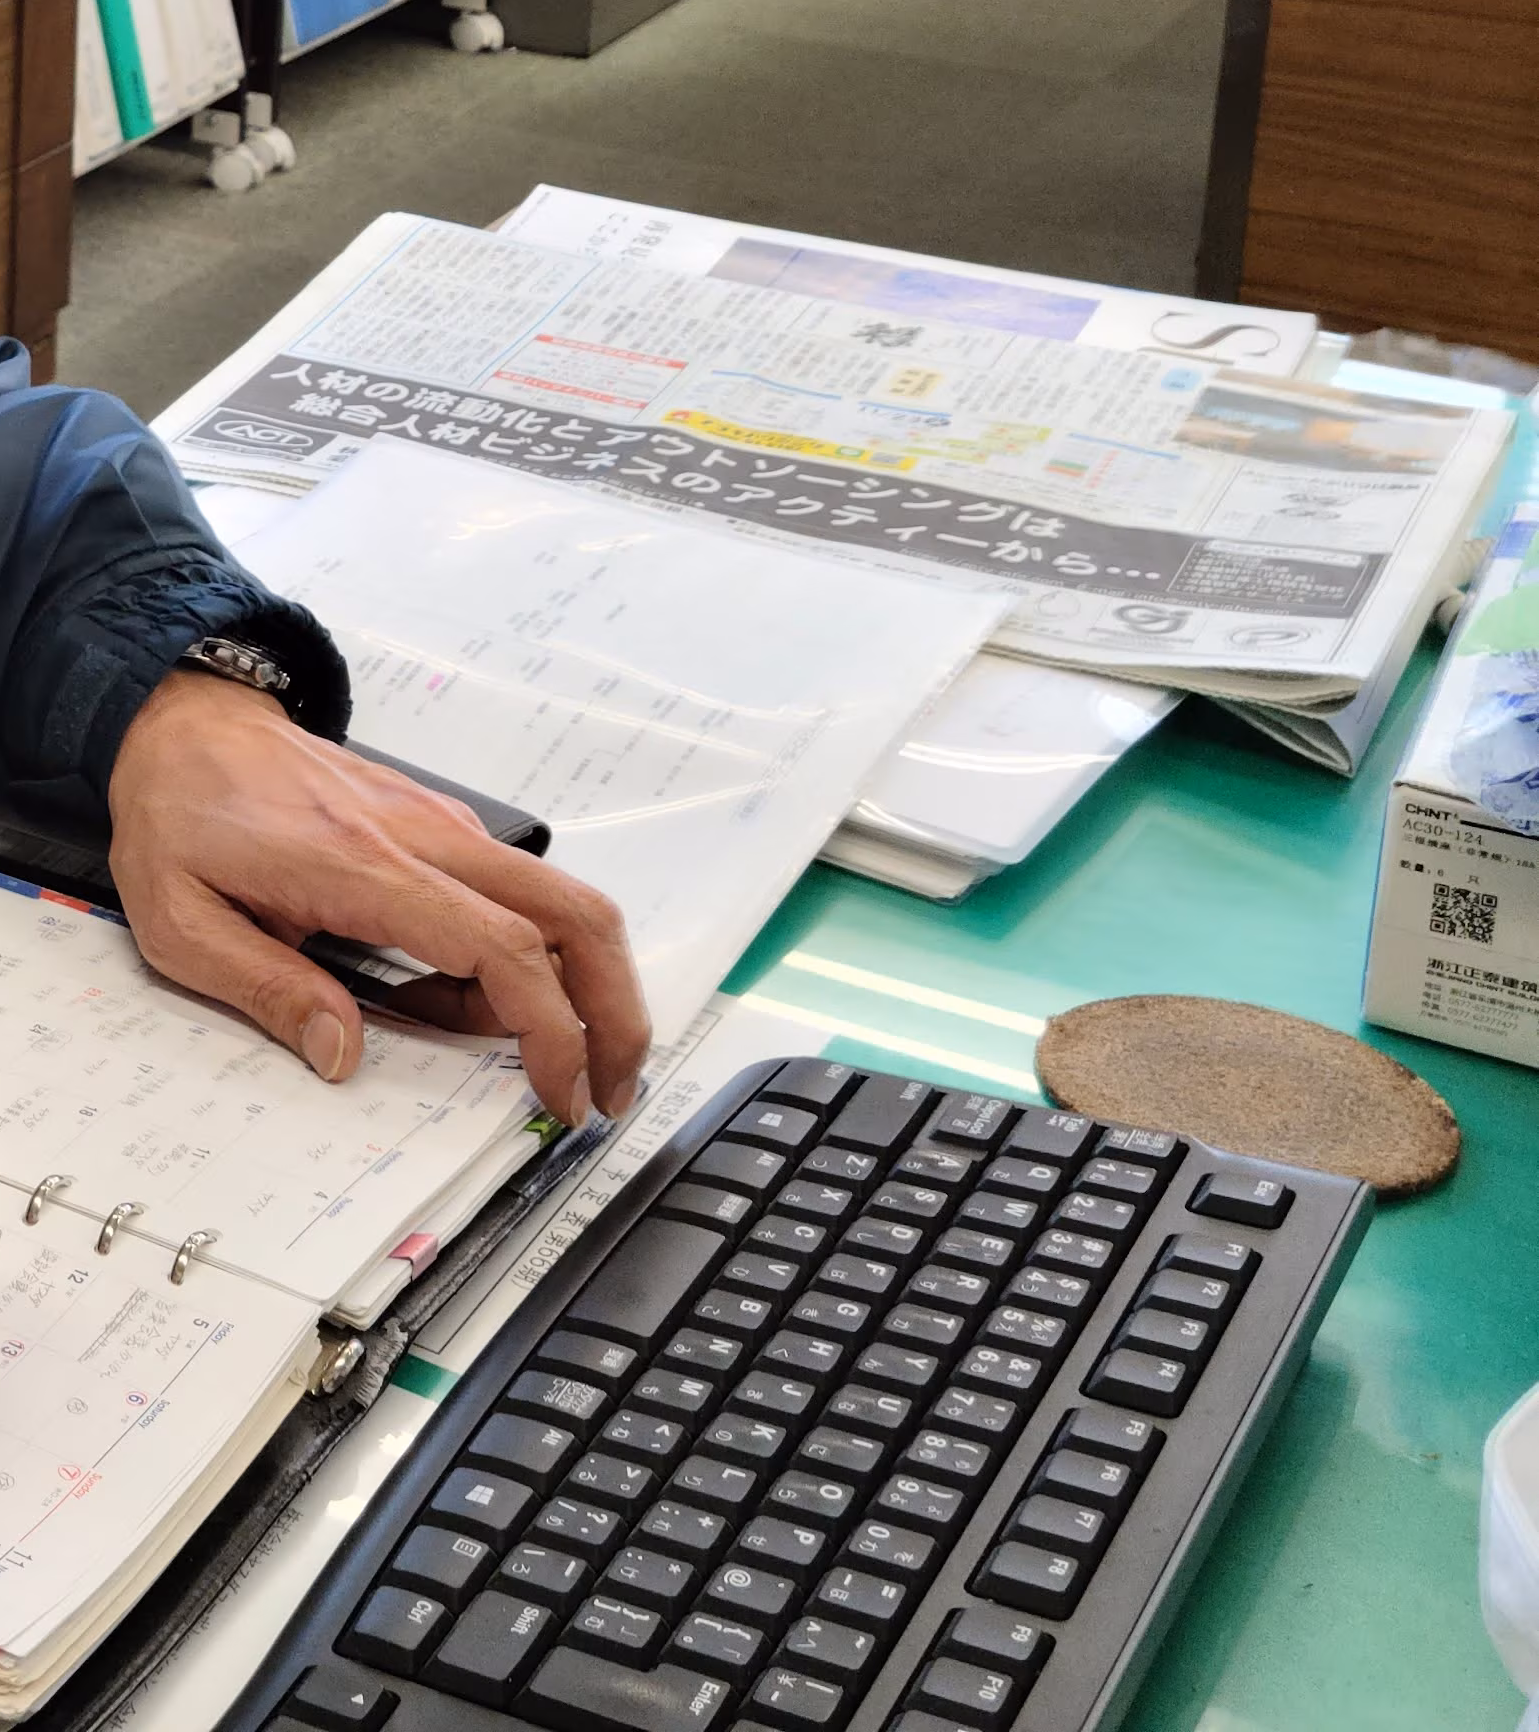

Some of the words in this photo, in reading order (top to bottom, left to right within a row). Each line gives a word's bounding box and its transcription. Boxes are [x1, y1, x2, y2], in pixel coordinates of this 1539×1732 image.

[270, 361, 1066, 540] 人材の流動化とアウトソーシングは
[1405, 803, 1452, 821] CHNT
[1403, 819, 1483, 845] AC30-124
[846, 1155, 868, 1166] Z
[938, 1156, 960, 1167] A
[1096, 1163, 1116, 1172] 1
[1028, 1168, 1051, 1179] Q
[821, 1189, 843, 1201] X
[1253, 1181, 1274, 1197] Esc
[916, 1192, 935, 1202] S
[1072, 1196, 1094, 1210] 2
[1004, 1202, 1027, 1218] W
[795, 1226, 814, 1238] C
[892, 1227, 913, 1239] D
[1051, 1234, 1073, 1244] 3
[981, 1238, 1004, 1251] E
[1224, 1243, 1243, 1257] F1
[769, 1264, 789, 1275] V
[67, 1270, 89, 1285] 12
[957, 1275, 980, 1288] R
[1027, 1272, 1048, 1283] 4
[1202, 1282, 1221, 1296] F2
[740, 1300, 761, 1313] B
[838, 1304, 858, 1316] G
[1003, 1310, 1024, 1321] 5
[193, 1317, 210, 1329] 5
[933, 1317, 954, 1329] T
[1181, 1321, 1199, 1336] F3
[209, 1322, 235, 1346] Friday
[2, 1341, 24, 1357] 13
[709, 1340, 732, 1353] N
[809, 1342, 833, 1356] H
[905, 1357, 929, 1369] Y
[978, 1350, 999, 1362] 6
[1157, 1362, 1178, 1378] F4
[679, 1380, 703, 1396] M
[782, 1384, 802, 1396] J
[128, 1394, 144, 1406] 6
[878, 1397, 901, 1411] U
[953, 1393, 974, 1406] 7
[138, 1399, 171, 1430] Saturday
[751, 1424, 776, 1440] K
[1125, 1420, 1145, 1436] F5
[852, 1439, 873, 1448] I
[925, 1436, 946, 1448] 8
[61, 1467, 79, 1480] 7
[722, 1468, 745, 1478] L
[1101, 1465, 1120, 1481] F6
[71, 1472, 103, 1500] Sunday
[820, 1485, 842, 1499] O
[898, 1480, 919, 1492] 9
[1075, 1511, 1095, 1529] F7
[793, 1530, 815, 1544] P
[868, 1526, 889, 1539] 0
[5, 1549, 33, 1569] 11
[1049, 1558, 1069, 1576] F8
[408, 1600, 432, 1624] Ctrl
[511, 1607, 539, 1635] Shift
[1012, 1625, 1031, 1642] F9
[979, 1676, 1004, 1700] F10
[689, 1681, 720, 1715] Enter
